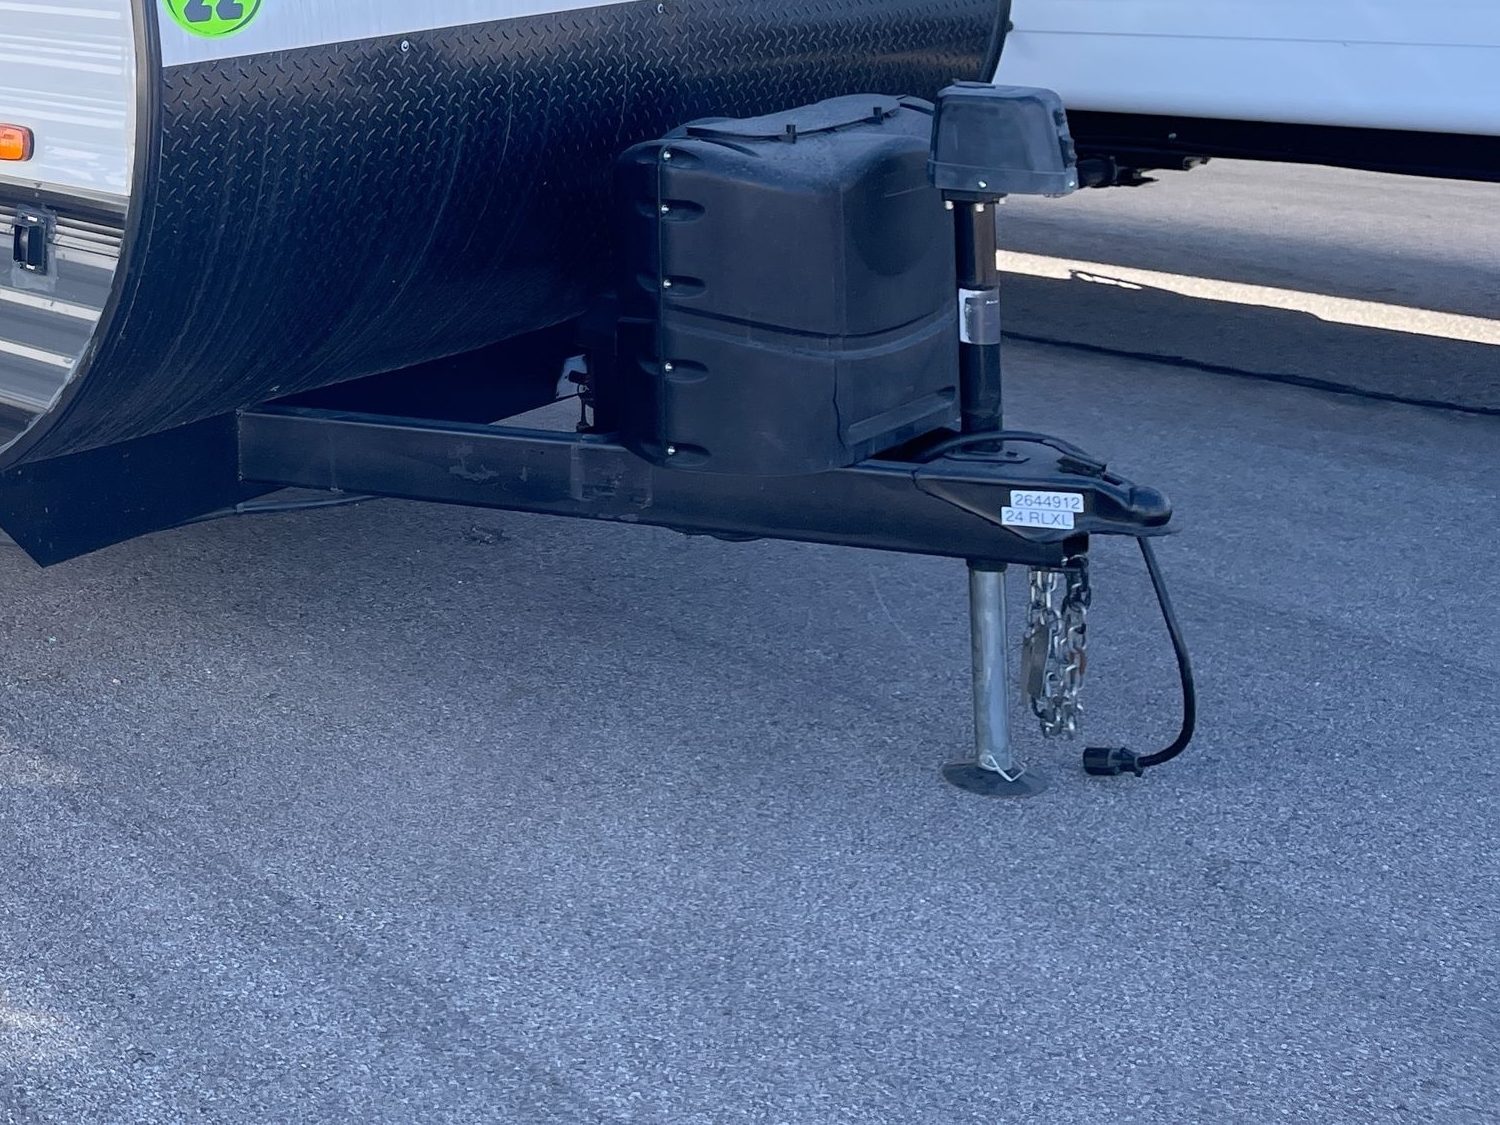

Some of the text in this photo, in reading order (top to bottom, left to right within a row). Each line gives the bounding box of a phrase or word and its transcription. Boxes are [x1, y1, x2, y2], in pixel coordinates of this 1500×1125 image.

[1014, 493, 1080, 510] 2644912
[1005, 510, 1071, 527] 24 RLXL
